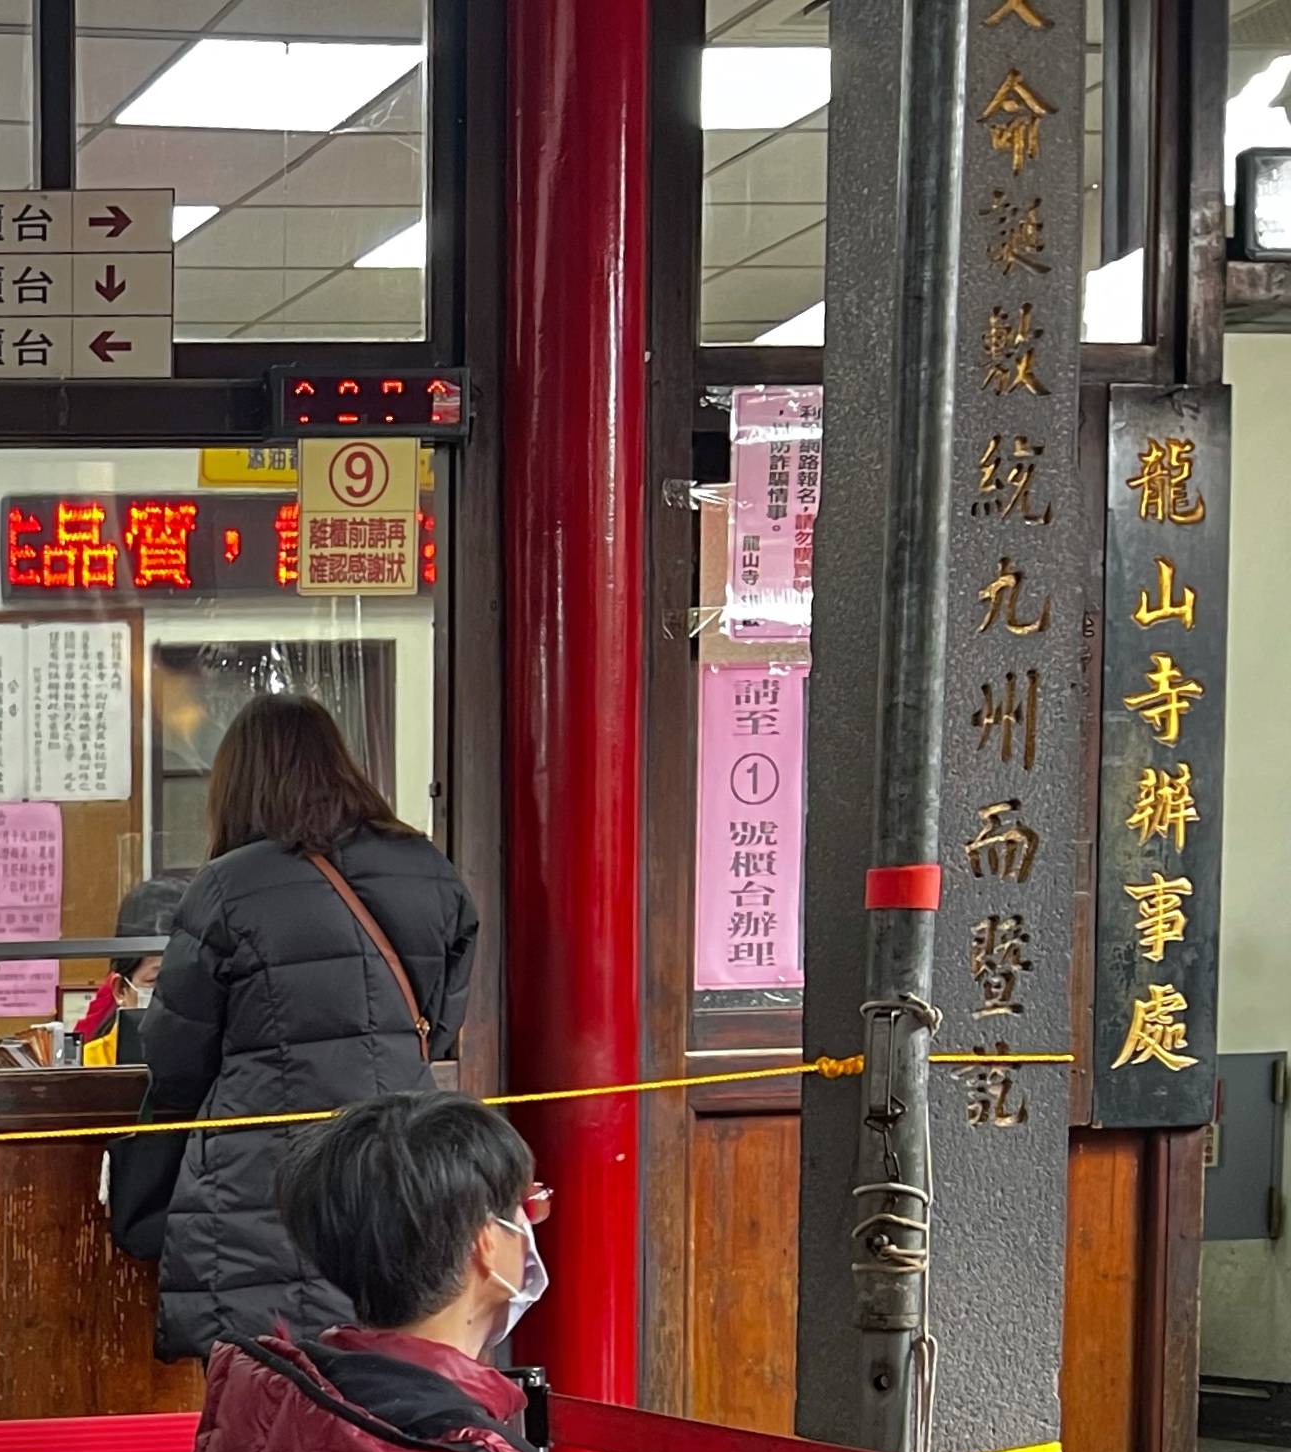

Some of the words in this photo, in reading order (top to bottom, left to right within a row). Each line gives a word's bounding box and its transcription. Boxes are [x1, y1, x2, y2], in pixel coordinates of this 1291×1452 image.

[308, 517, 407, 550] 離櫃前請再
[308, 552, 407, 585] 確認感謝狀
[731, 678, 781, 737] 請至
[1110, 436, 1207, 1072] 龍山寺辦事處
[727, 820, 779, 968] 號櫃台辦理
